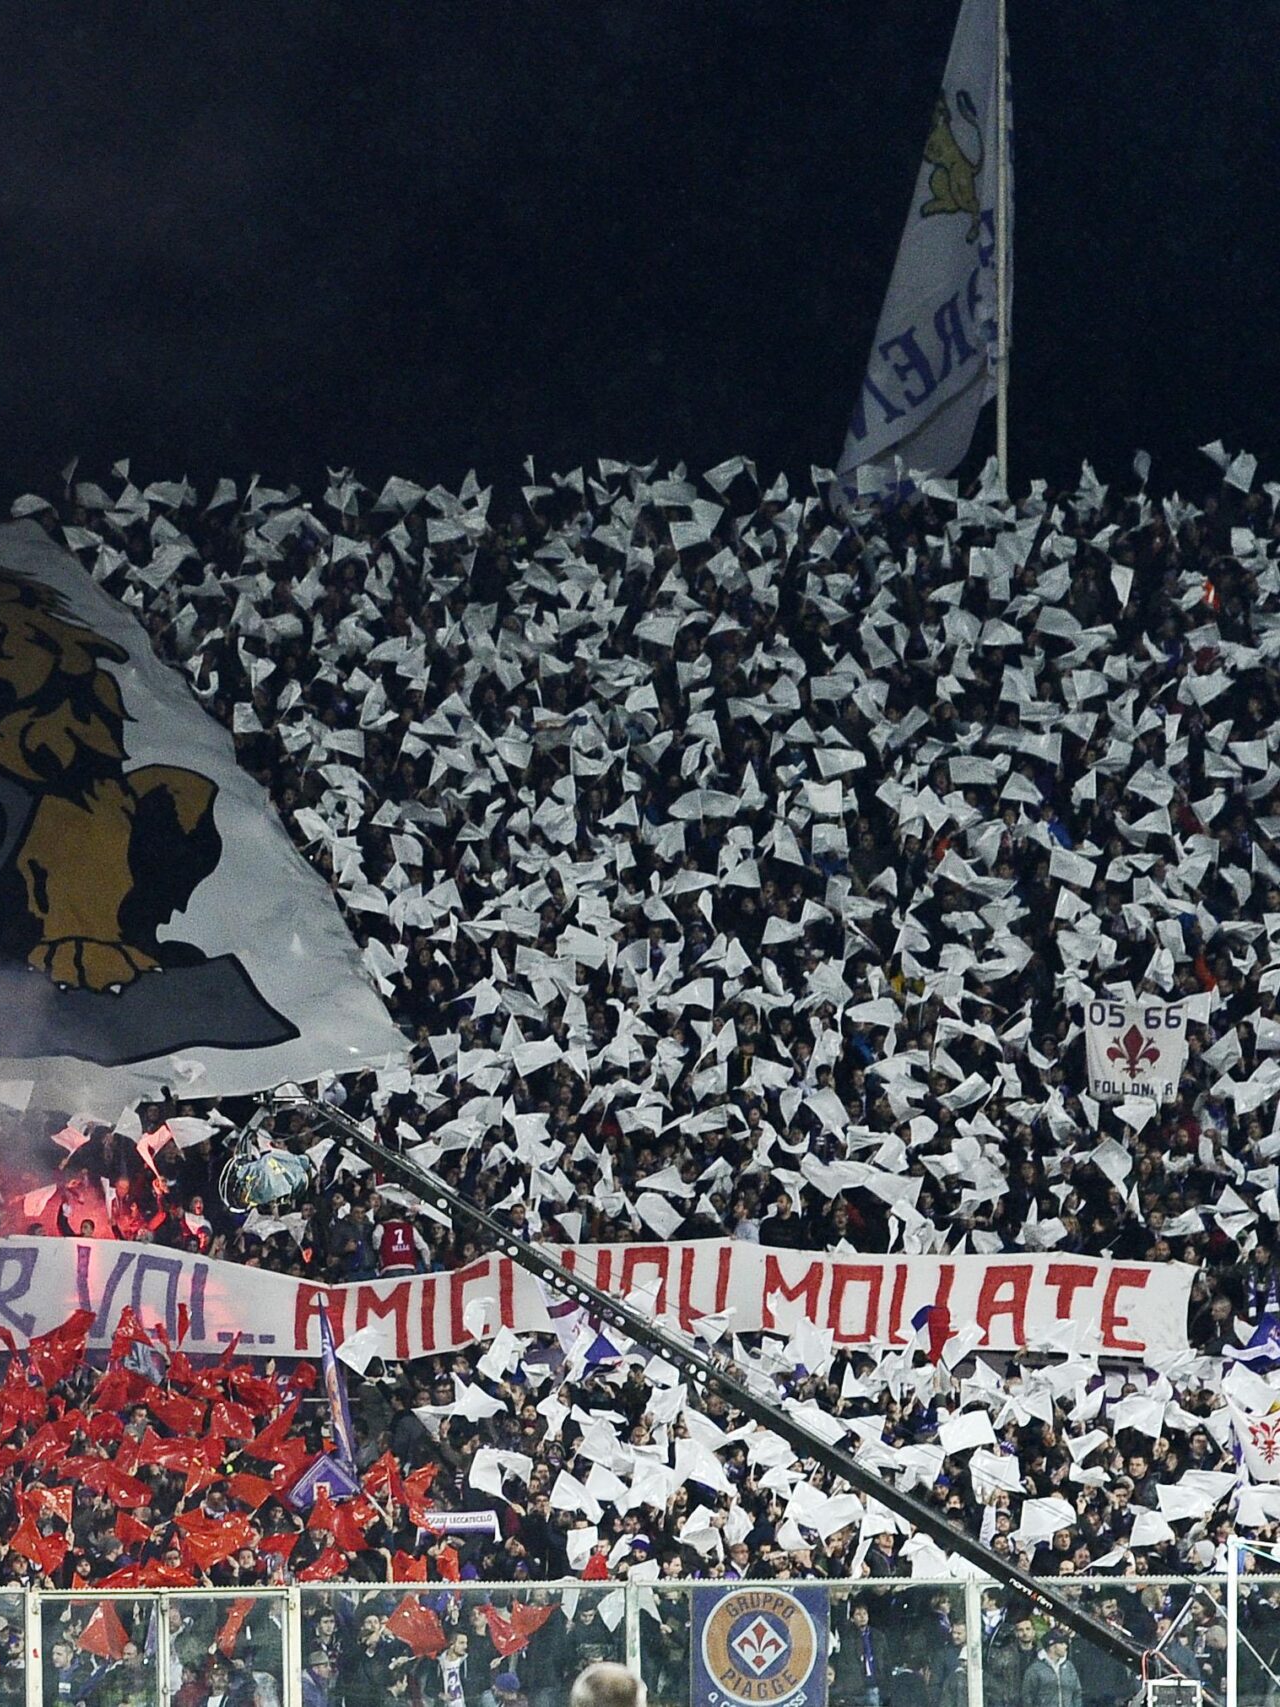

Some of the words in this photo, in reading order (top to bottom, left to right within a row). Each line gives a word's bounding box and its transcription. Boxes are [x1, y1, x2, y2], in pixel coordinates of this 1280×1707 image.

[1089, 1002, 1125, 1028] 05
[1145, 1005, 1183, 1029] 66
[294, 1258, 515, 1359] AMICI
[762, 1254, 1152, 1352] MOLLATE
[725, 1591, 796, 1620] GRUPPO
[720, 1668, 798, 1699] PIAGGE
